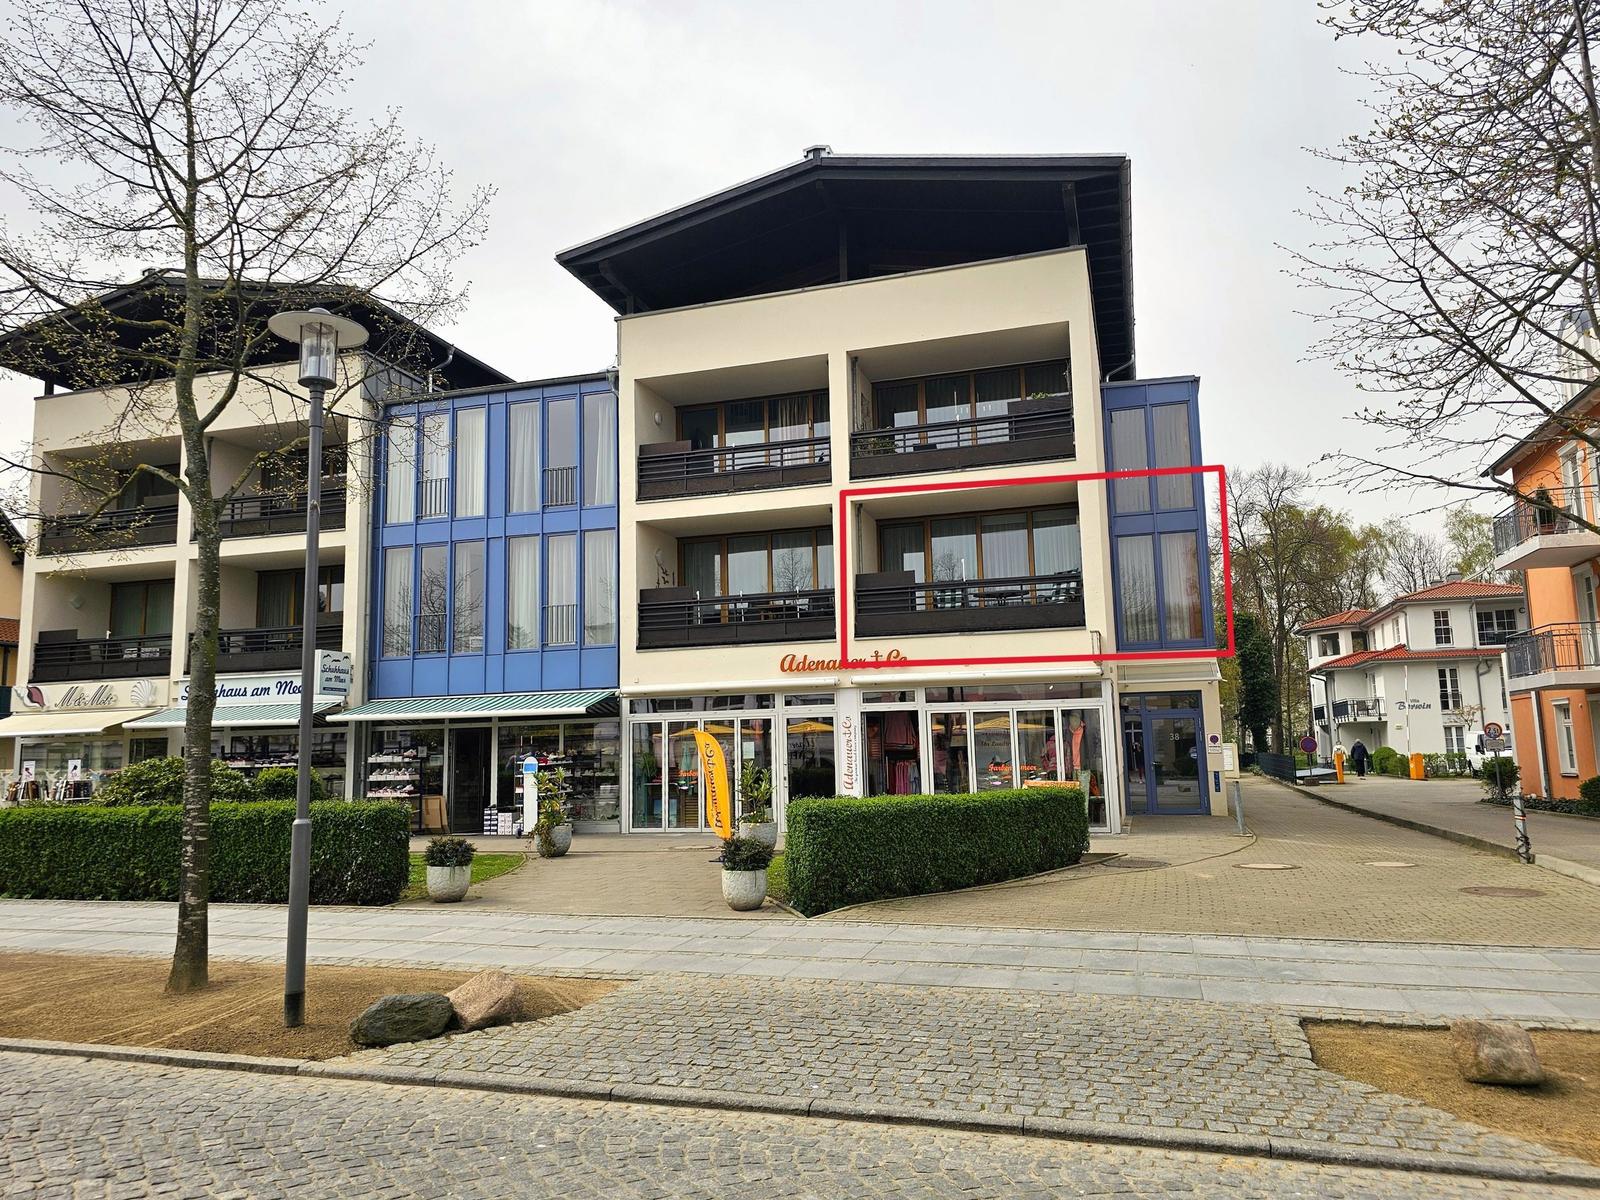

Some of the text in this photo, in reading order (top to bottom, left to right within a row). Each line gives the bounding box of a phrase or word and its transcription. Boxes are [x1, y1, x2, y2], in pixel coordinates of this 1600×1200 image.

[780, 653, 867, 672] Adena
[181, 680, 302, 700] Shaus am Mee
[1170, 732, 1180, 741] 38
